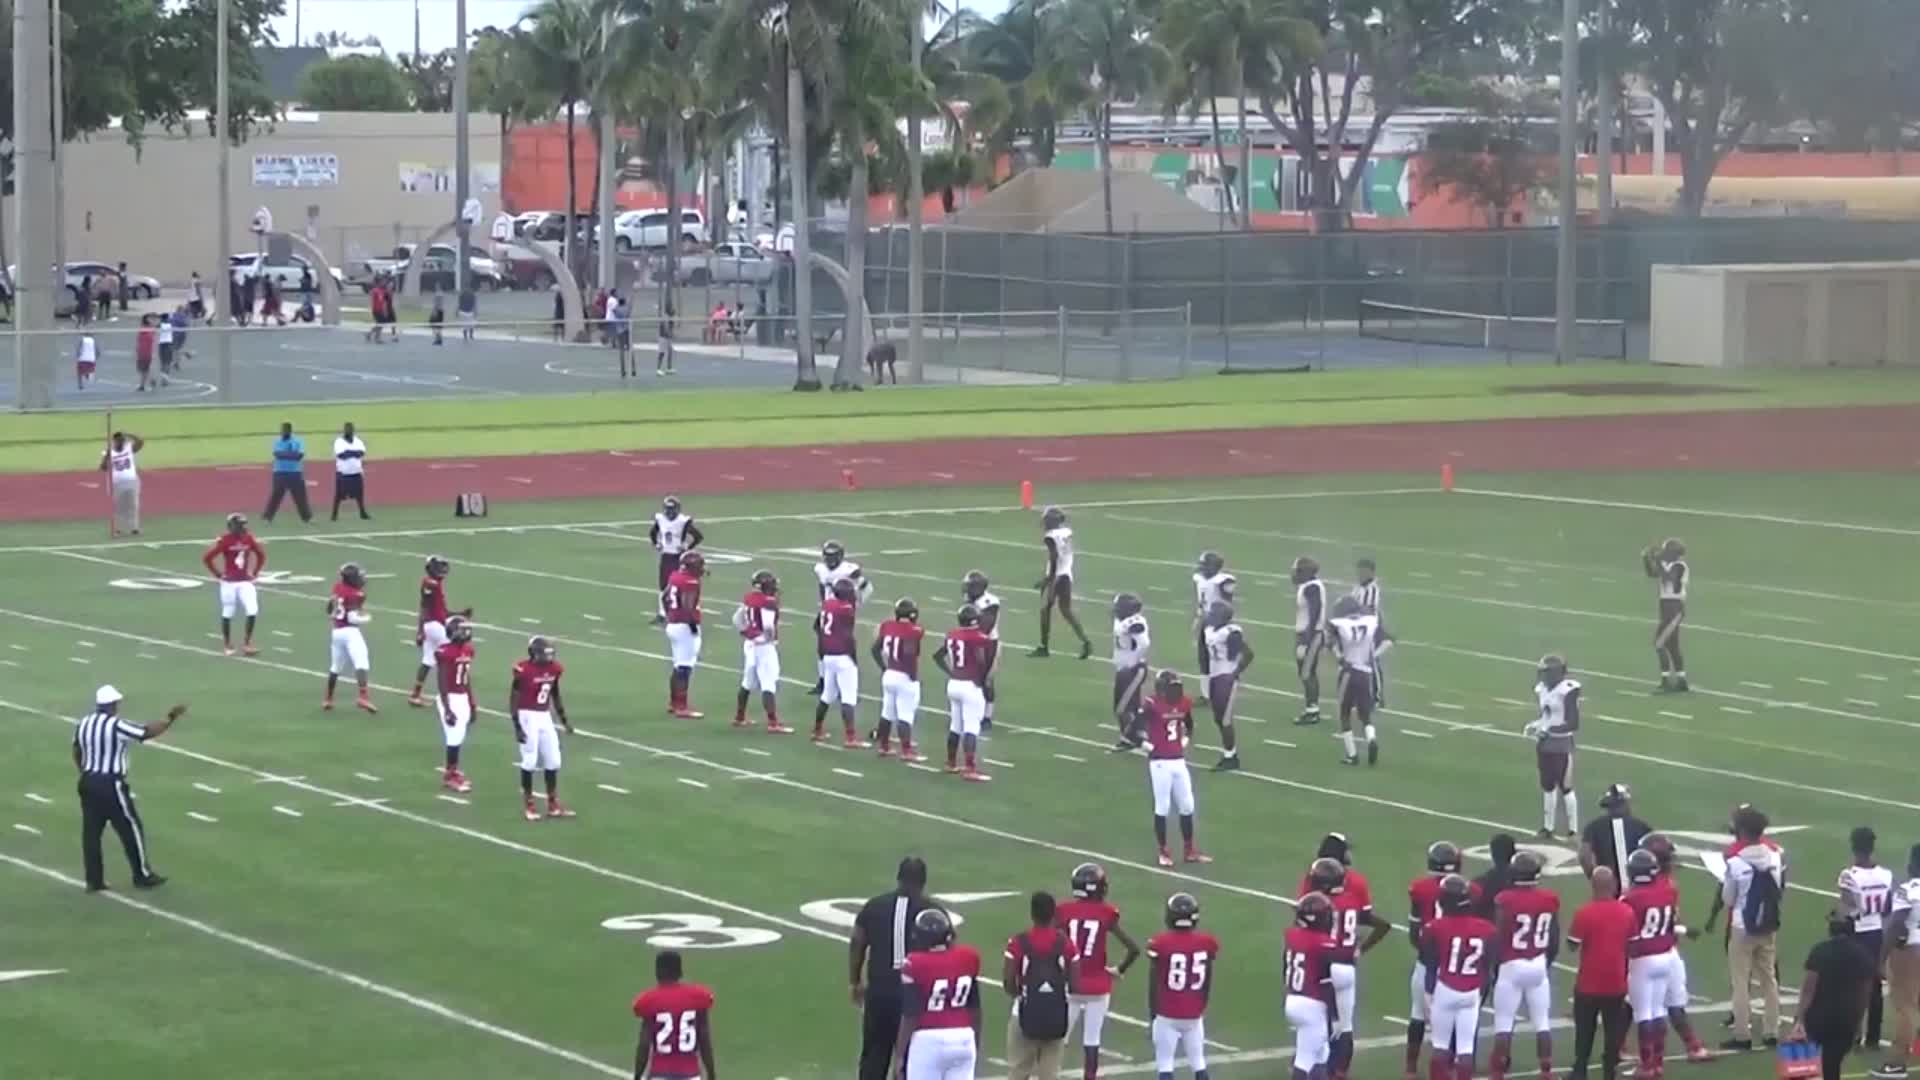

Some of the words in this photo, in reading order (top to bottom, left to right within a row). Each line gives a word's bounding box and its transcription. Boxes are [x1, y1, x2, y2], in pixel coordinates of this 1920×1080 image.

[233, 550, 247, 570] 4
[1351, 625, 1368, 642] 17
[1639, 904, 1672, 940] 81
[1864, 895, 1884, 913] 11
[1069, 918, 1100, 958] 17
[1512, 912, 1552, 950] 20
[1167, 950, 1209, 992] 85
[1448, 936, 1484, 976] 12
[655, 1010, 698, 1054] 26
